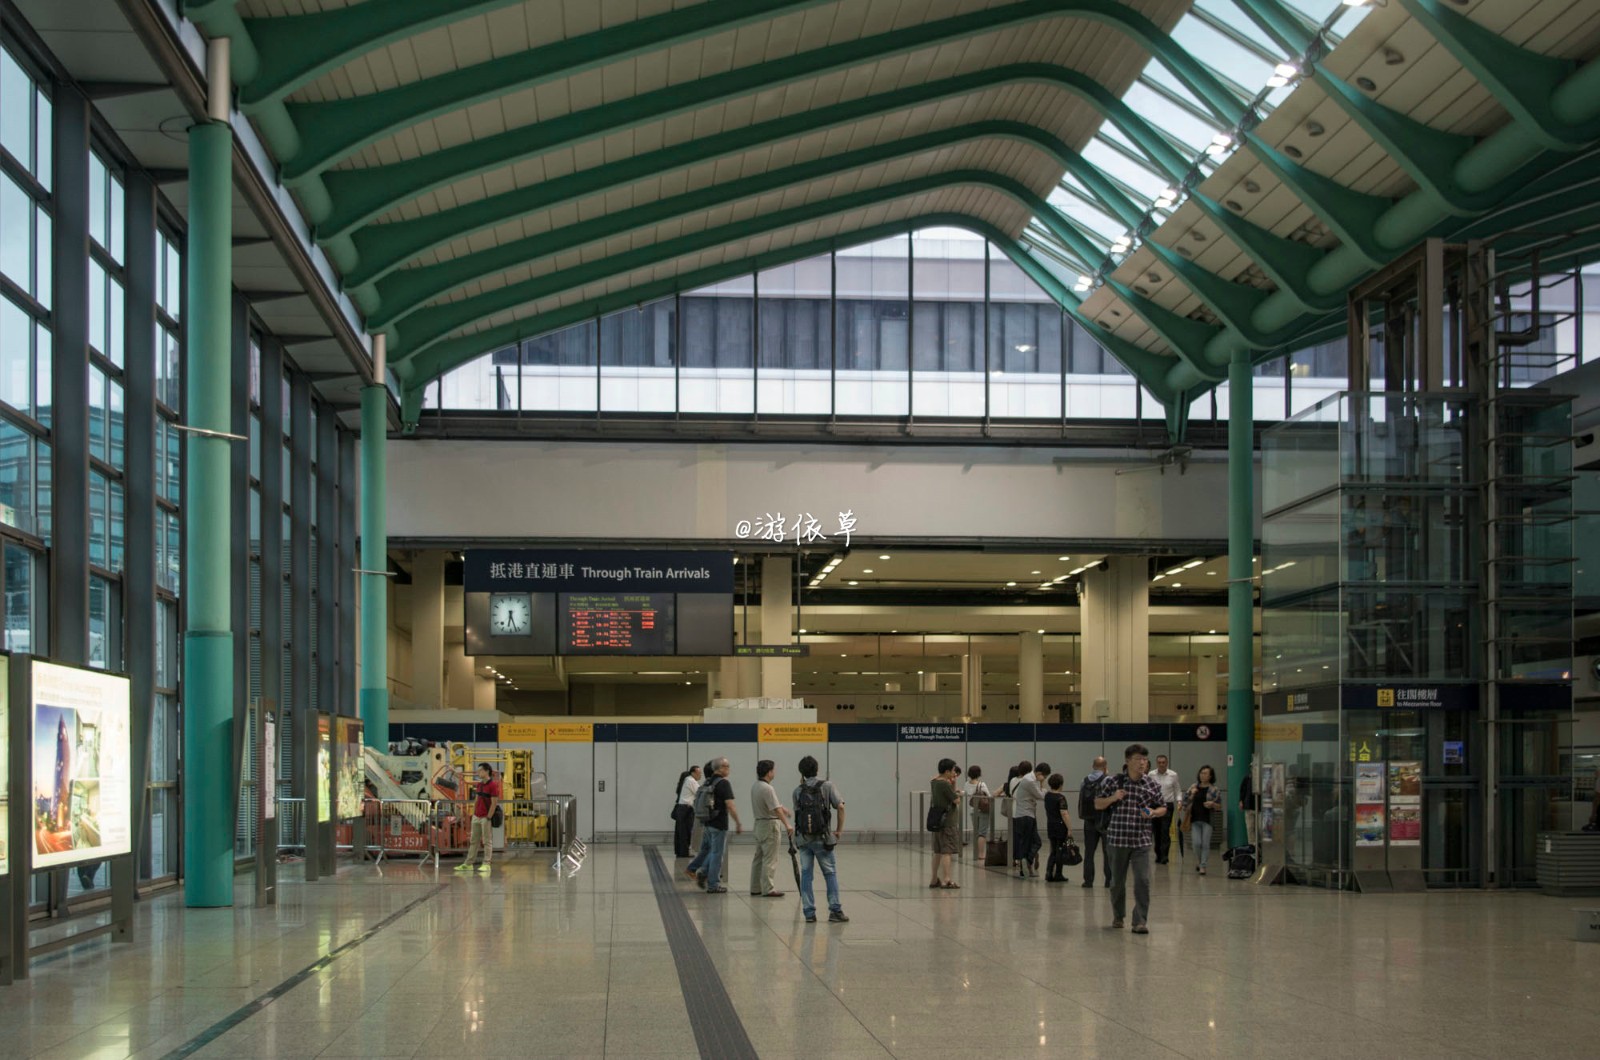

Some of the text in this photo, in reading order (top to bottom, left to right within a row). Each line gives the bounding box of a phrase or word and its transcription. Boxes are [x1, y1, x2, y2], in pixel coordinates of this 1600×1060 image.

[490, 562, 575, 580] 抵港直通車
[581, 567, 710, 581] Through Train Arrivals
